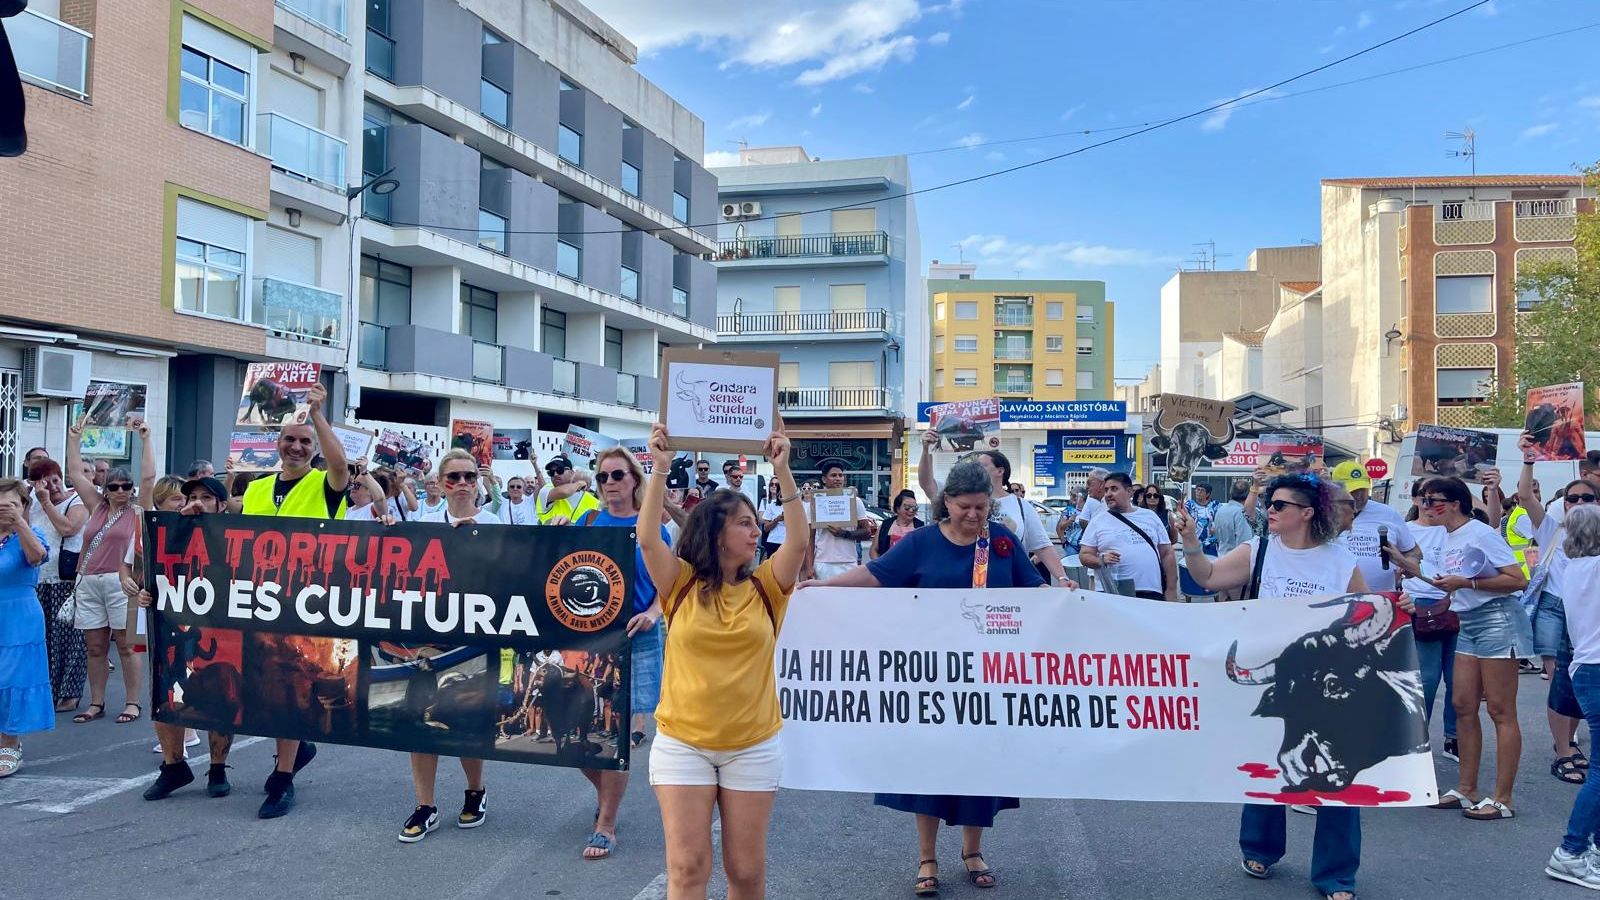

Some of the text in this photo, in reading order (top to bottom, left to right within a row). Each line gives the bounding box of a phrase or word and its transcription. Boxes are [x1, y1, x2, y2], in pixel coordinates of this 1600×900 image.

[249, 362, 314, 372] ESTO NUNCA
[279, 371, 317, 383] ARTE
[709, 382, 757, 394] Ondara
[709, 393, 744, 404] sense
[709, 404, 757, 415] crueltat
[933, 399, 993, 413] ESTO NUNCA
[962, 405, 997, 417] ARTE
[999, 401, 1120, 413] OLAVADO SAN CRISTÓBAL
[708, 414, 753, 425] animal
[1175, 410, 1209, 423] INOCENTE
[1066, 438, 1111, 446] GOODYEAR
[1226, 455, 1258, 465] 630 01
[156, 526, 450, 590] LA TORTURA
[572, 554, 606, 567] ANIMAL
[605, 564, 622, 587] SAVE
[1284, 586, 1315, 596] sense
[1286, 578, 1326, 592] Ondara
[155, 574, 540, 637] NO ES CULTURA
[985, 604, 1021, 613] Ondara
[548, 595, 621, 629] ANIMAL SAVE MOVEMENT
[986, 620, 1022, 628] crueltat
[986, 627, 1020, 635] animal
[779, 648, 1199, 688] JA HI HA PROU DE MALTRACTAMENT.
[779, 687, 1200, 731] ONDARA NO ES VOL TACAR DE SANG!
